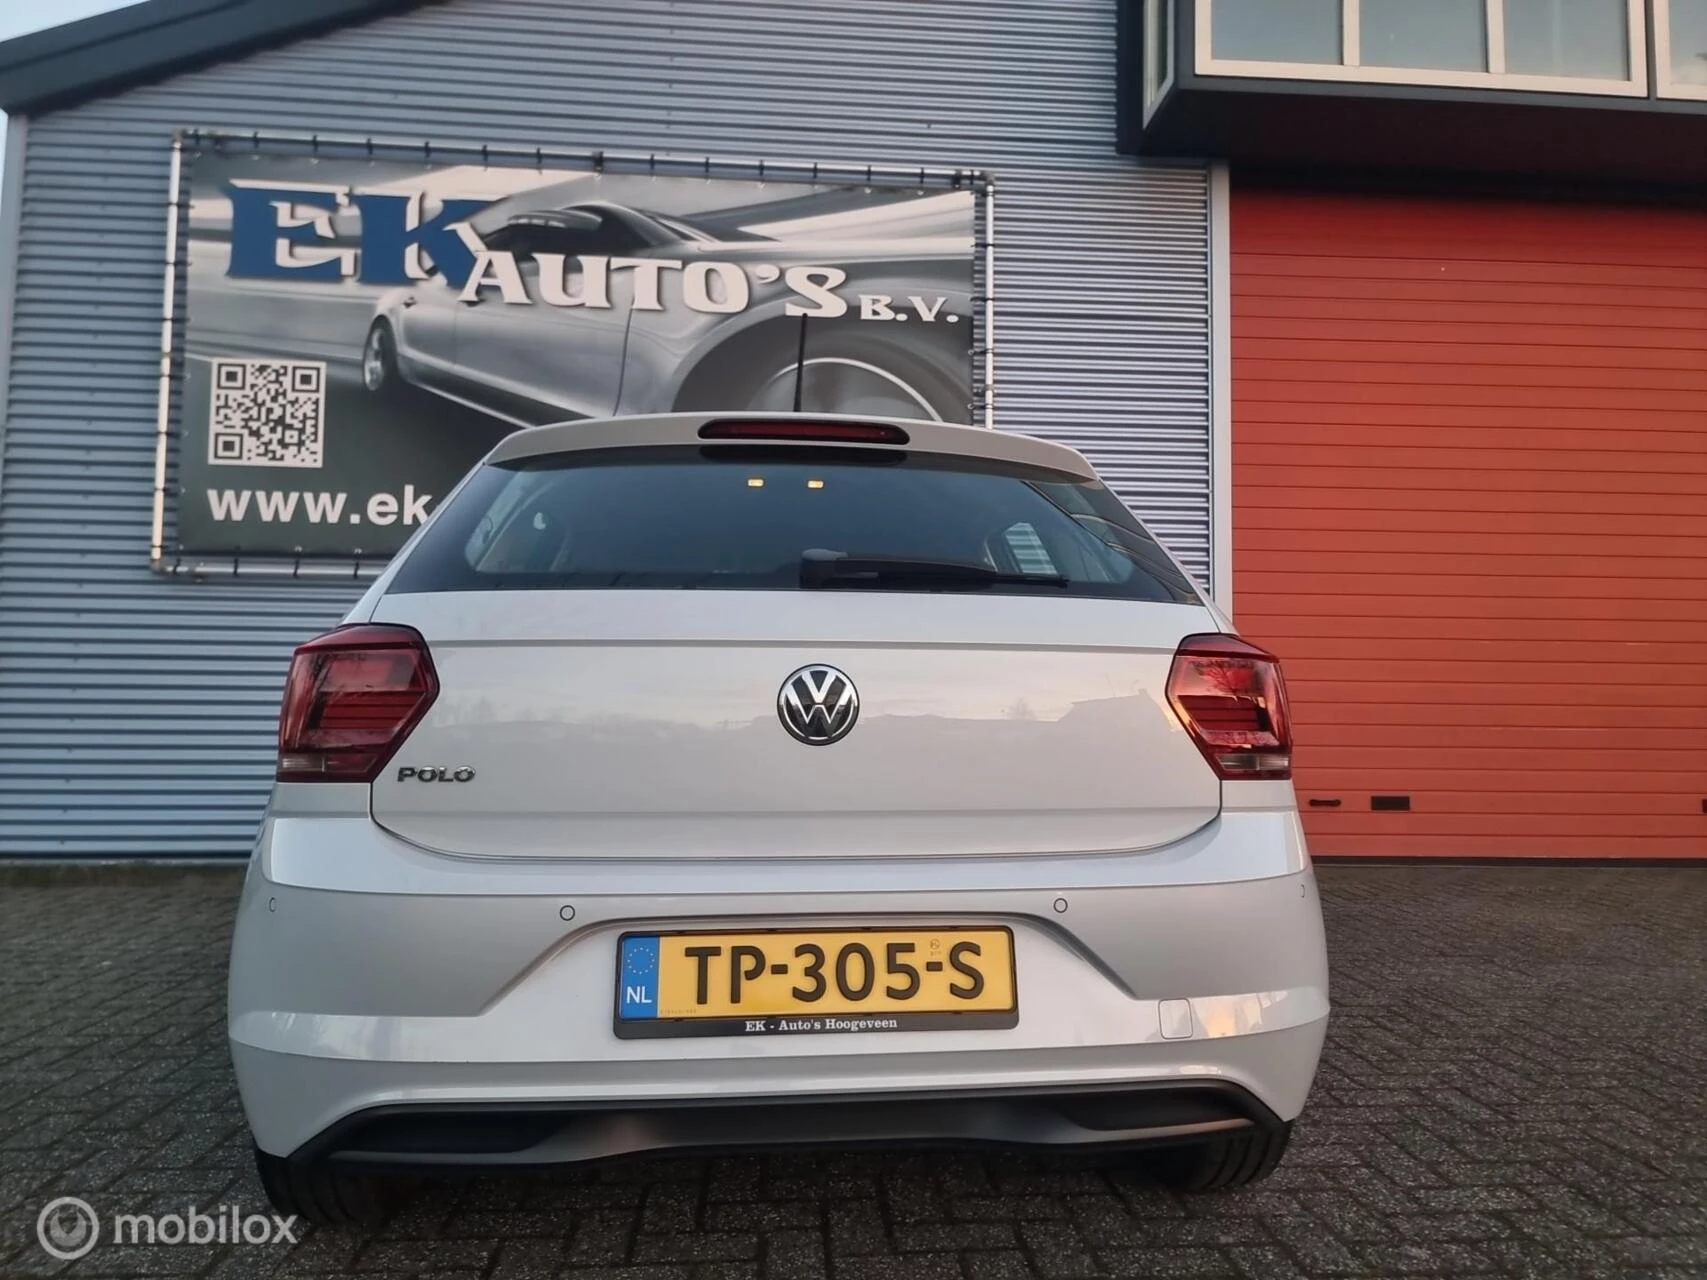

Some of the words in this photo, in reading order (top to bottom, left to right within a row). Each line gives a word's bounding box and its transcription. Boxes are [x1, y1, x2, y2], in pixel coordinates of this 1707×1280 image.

[224, 178, 512, 290] EK
[455, 250, 849, 318] AUTO'S
[857, 294, 960, 323] B.V.
[397, 766, 475, 783] POLO
[685, 941, 985, 1004] TP-305-S
[626, 986, 652, 1004] NL
[745, 1020, 766, 1032] EK
[778, 1019, 821, 1031] Auto's
[825, 1018, 898, 1031] Hoogeveen
